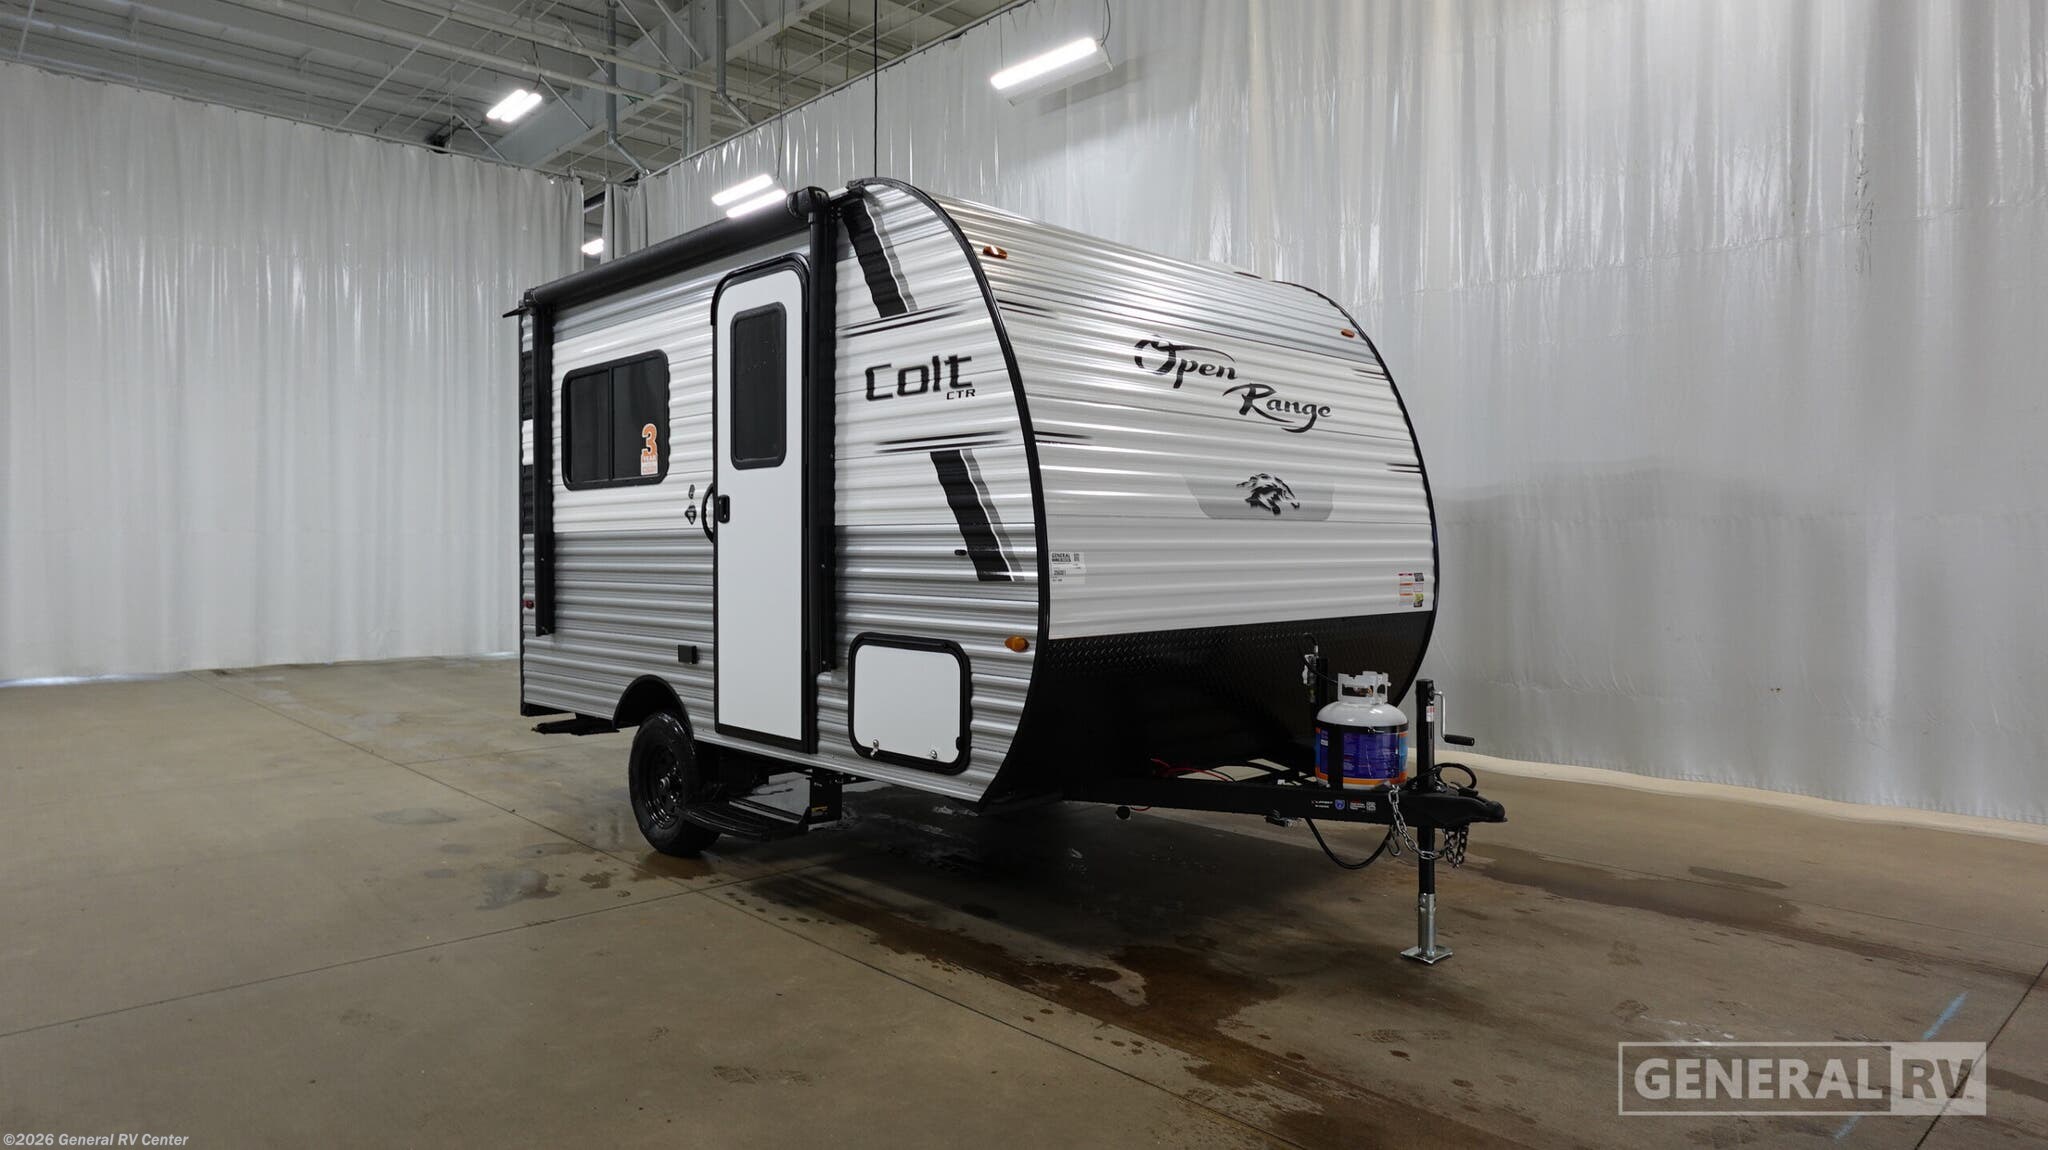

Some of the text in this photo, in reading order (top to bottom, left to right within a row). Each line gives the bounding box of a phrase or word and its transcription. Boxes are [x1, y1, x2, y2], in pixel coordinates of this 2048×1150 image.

[865, 355, 973, 401] Colt
[1134, 335, 1238, 389] Open
[946, 388, 976, 400] CTR
[1222, 383, 1333, 433] Range
[641, 423, 658, 456] 3
